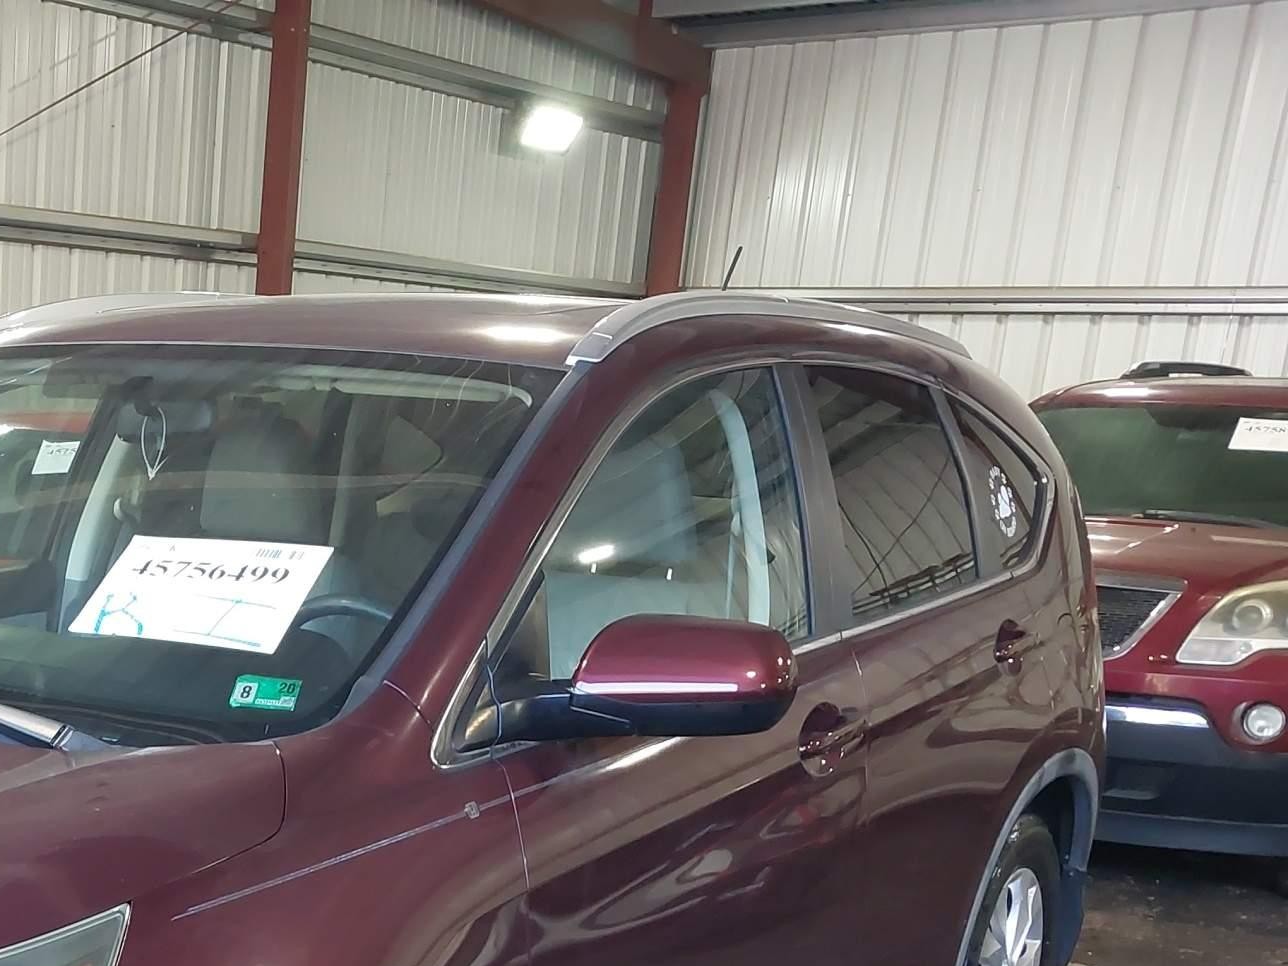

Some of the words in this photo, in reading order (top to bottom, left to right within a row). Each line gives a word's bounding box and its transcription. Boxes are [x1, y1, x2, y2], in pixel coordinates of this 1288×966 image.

[132, 559, 290, 585] 45756499
[240, 685, 253, 699] 8
[278, 682, 297, 695] 20
